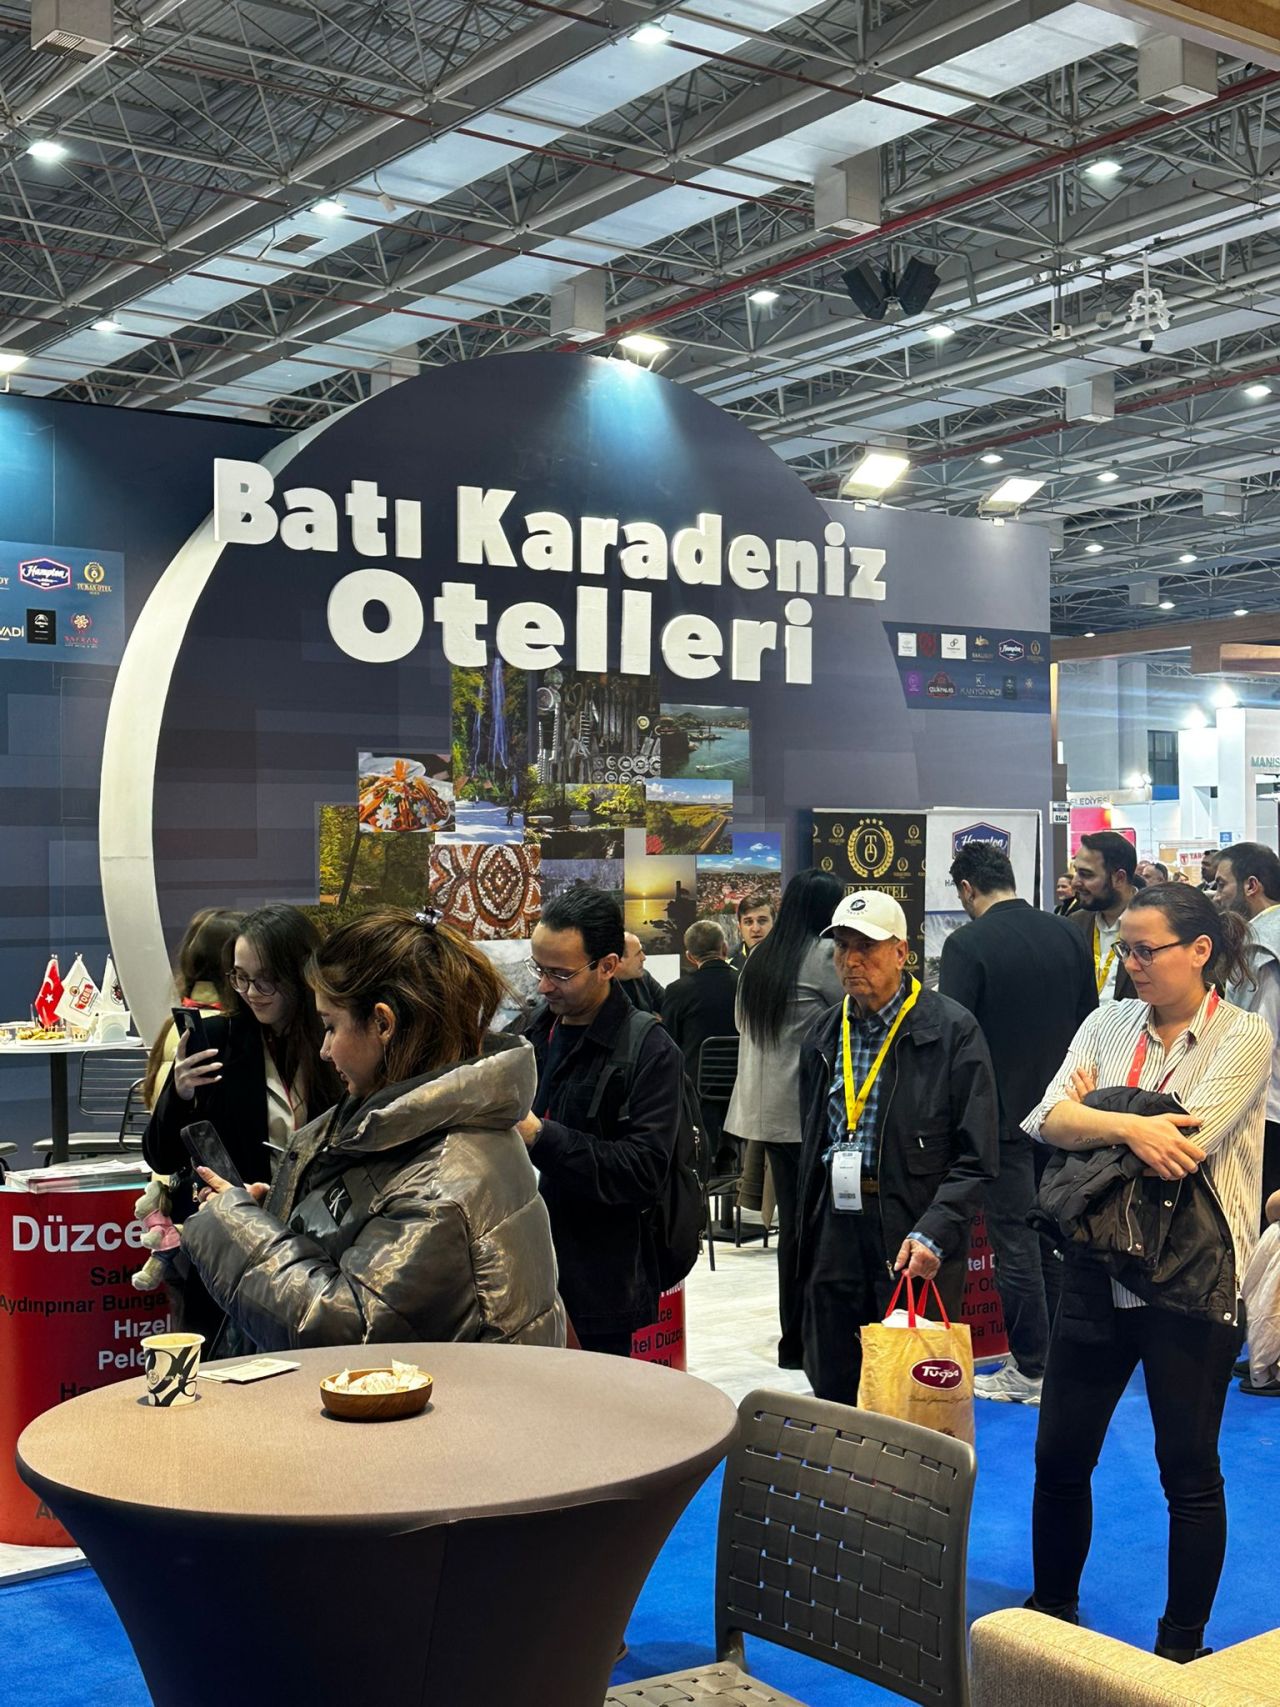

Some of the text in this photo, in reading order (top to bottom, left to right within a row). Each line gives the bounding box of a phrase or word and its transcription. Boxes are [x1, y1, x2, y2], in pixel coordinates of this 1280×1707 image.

[213, 457, 887, 601] Batı Karadeniz
[327, 568, 813, 685] Otelleri
[12, 1215, 147, 1252] Düzce
[114, 1313, 171, 1340] Hızel
